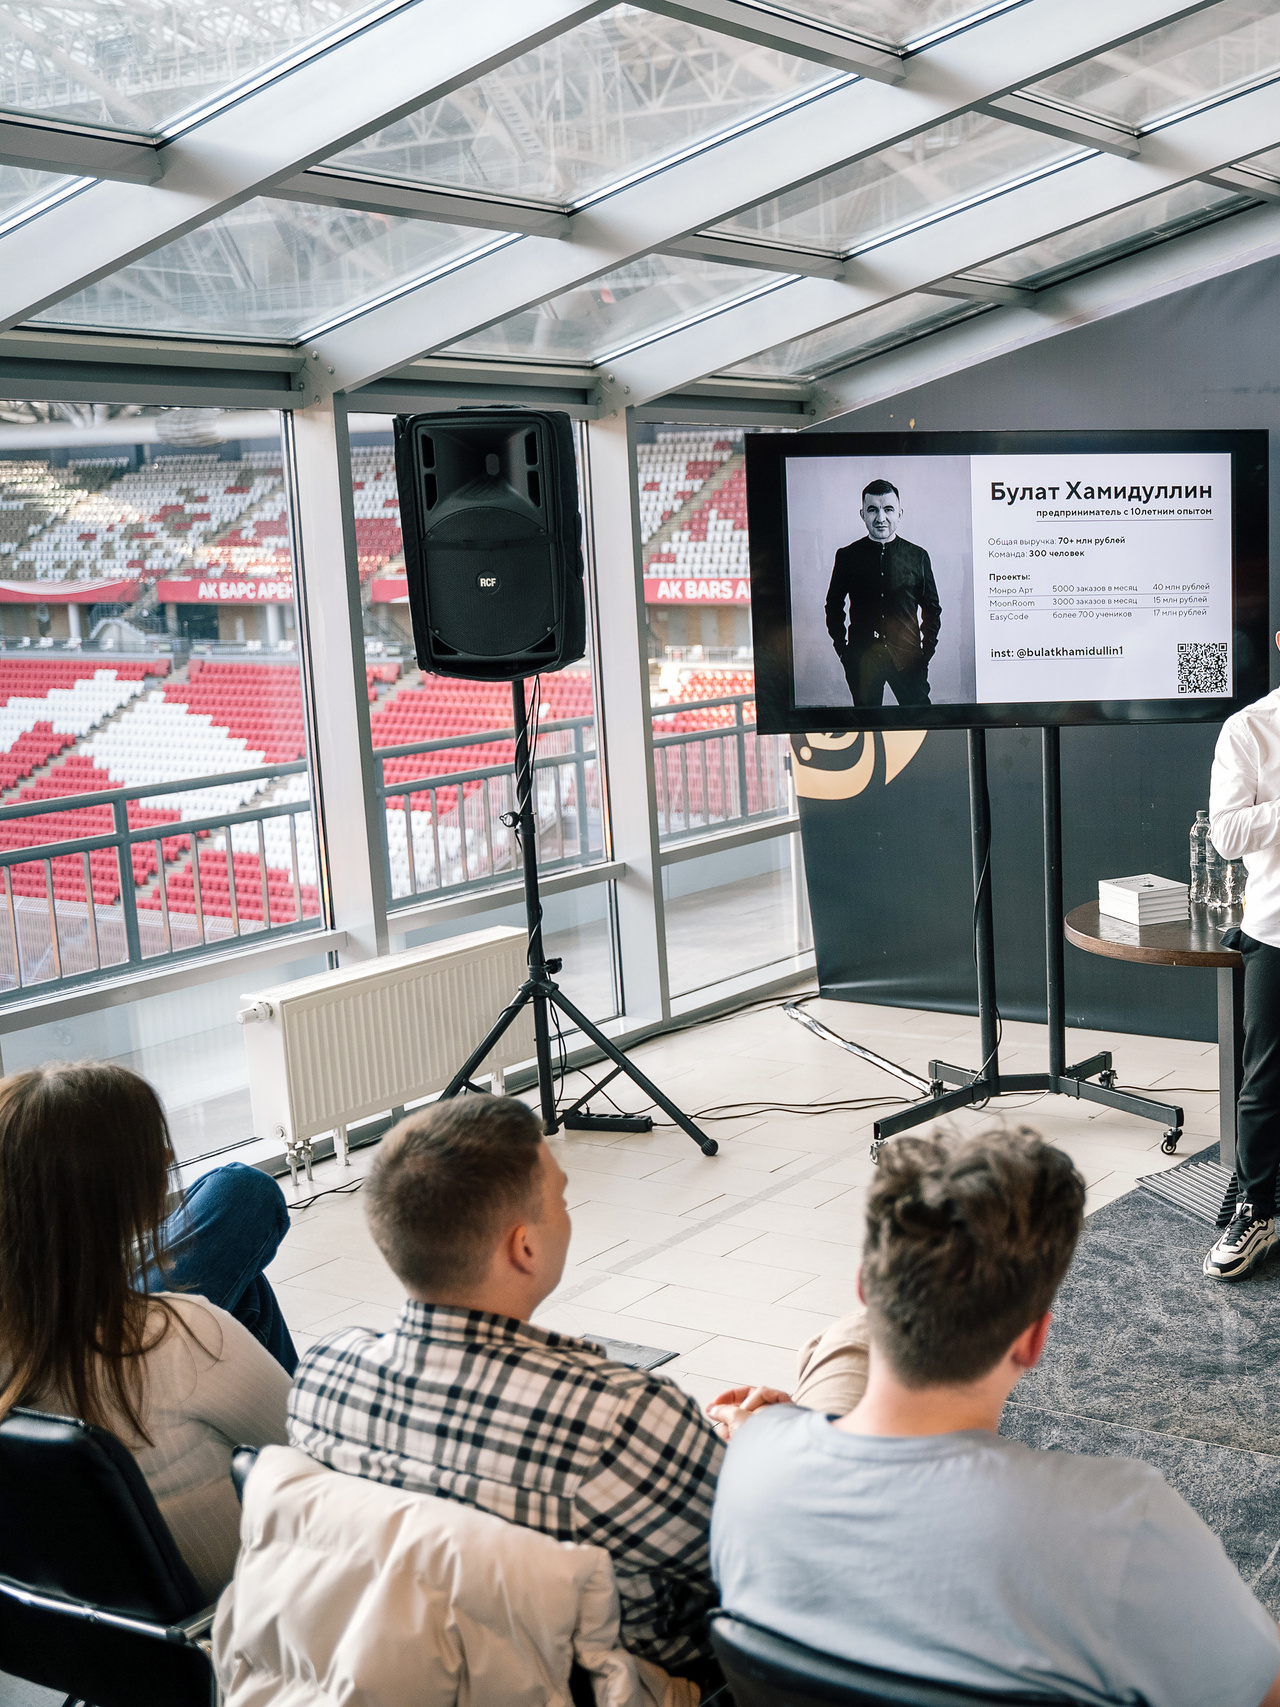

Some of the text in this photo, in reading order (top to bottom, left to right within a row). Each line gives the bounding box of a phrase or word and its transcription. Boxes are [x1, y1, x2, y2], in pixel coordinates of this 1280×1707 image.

[990, 481, 1212, 506] Булат Хамидуллин
[1036, 509, 1121, 518] предприниматель
[1130, 507, 1175, 516] 10летним
[988, 537, 1018, 546] Общая
[1019, 538, 1057, 547] выручка:
[1058, 536, 1074, 545] 70+
[1094, 536, 1126, 546] рублей
[988, 550, 1028, 559] Команда:
[1029, 549, 1047, 558] 300
[479, 577, 497, 587] RCF
[989, 573, 1031, 583] Проекты:
[197, 581, 218, 599] АК
[218, 581, 257, 599] БАРС
[657, 580, 683, 600] AK
[684, 580, 734, 600] BARS
[989, 586, 1034, 596] Монро Арт
[1052, 584, 1075, 593] 5000
[1152, 583, 1164, 591] 40
[1181, 582, 1210, 592] рублей
[989, 599, 1035, 608] MoonRoom
[1052, 597, 1075, 606] 3000
[1153, 596, 1161, 604] 15
[1179, 595, 1208, 605] рублей
[989, 612, 1029, 622] EasyCode
[1052, 610, 1132, 620] более 700 учеников
[1178, 608, 1207, 618] рублей
[990, 645, 1123, 659] inst: @bulatkhamidullin1
